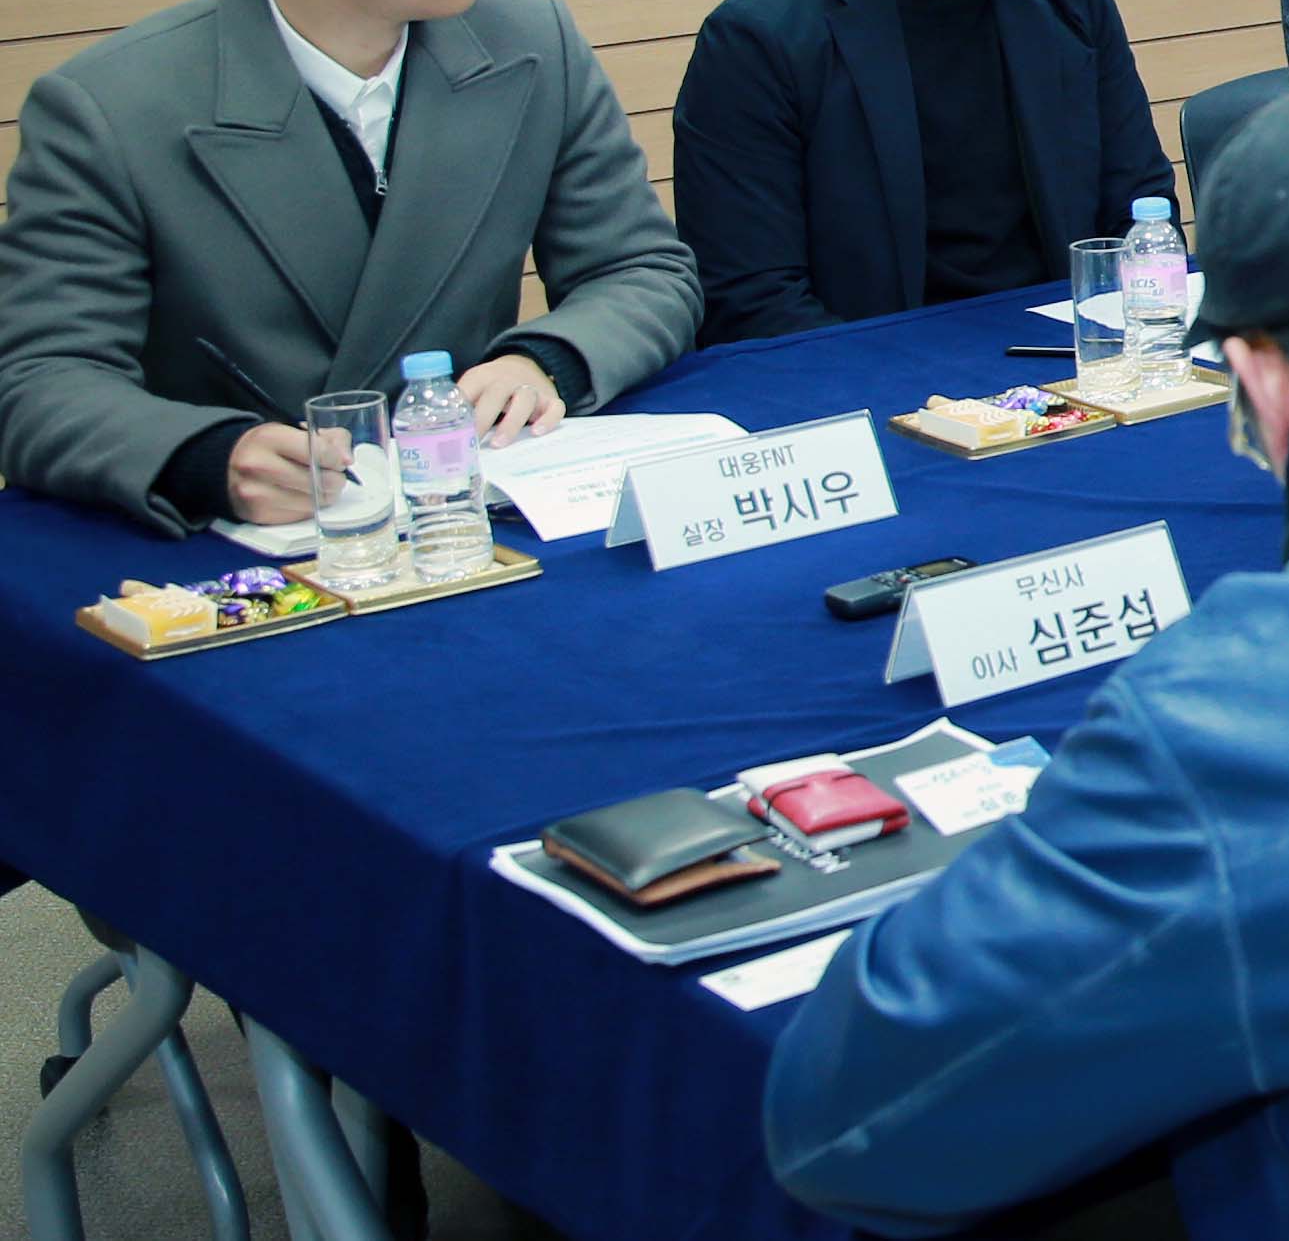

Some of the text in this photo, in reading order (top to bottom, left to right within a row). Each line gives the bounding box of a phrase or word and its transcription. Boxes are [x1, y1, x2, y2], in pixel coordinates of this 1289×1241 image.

[718, 444, 795, 479] 대웅FNT
[682, 471, 860, 547] 실장 박시우
[1015, 562, 1086, 601] 무신사
[971, 588, 1160, 680] 이사 심준섭
